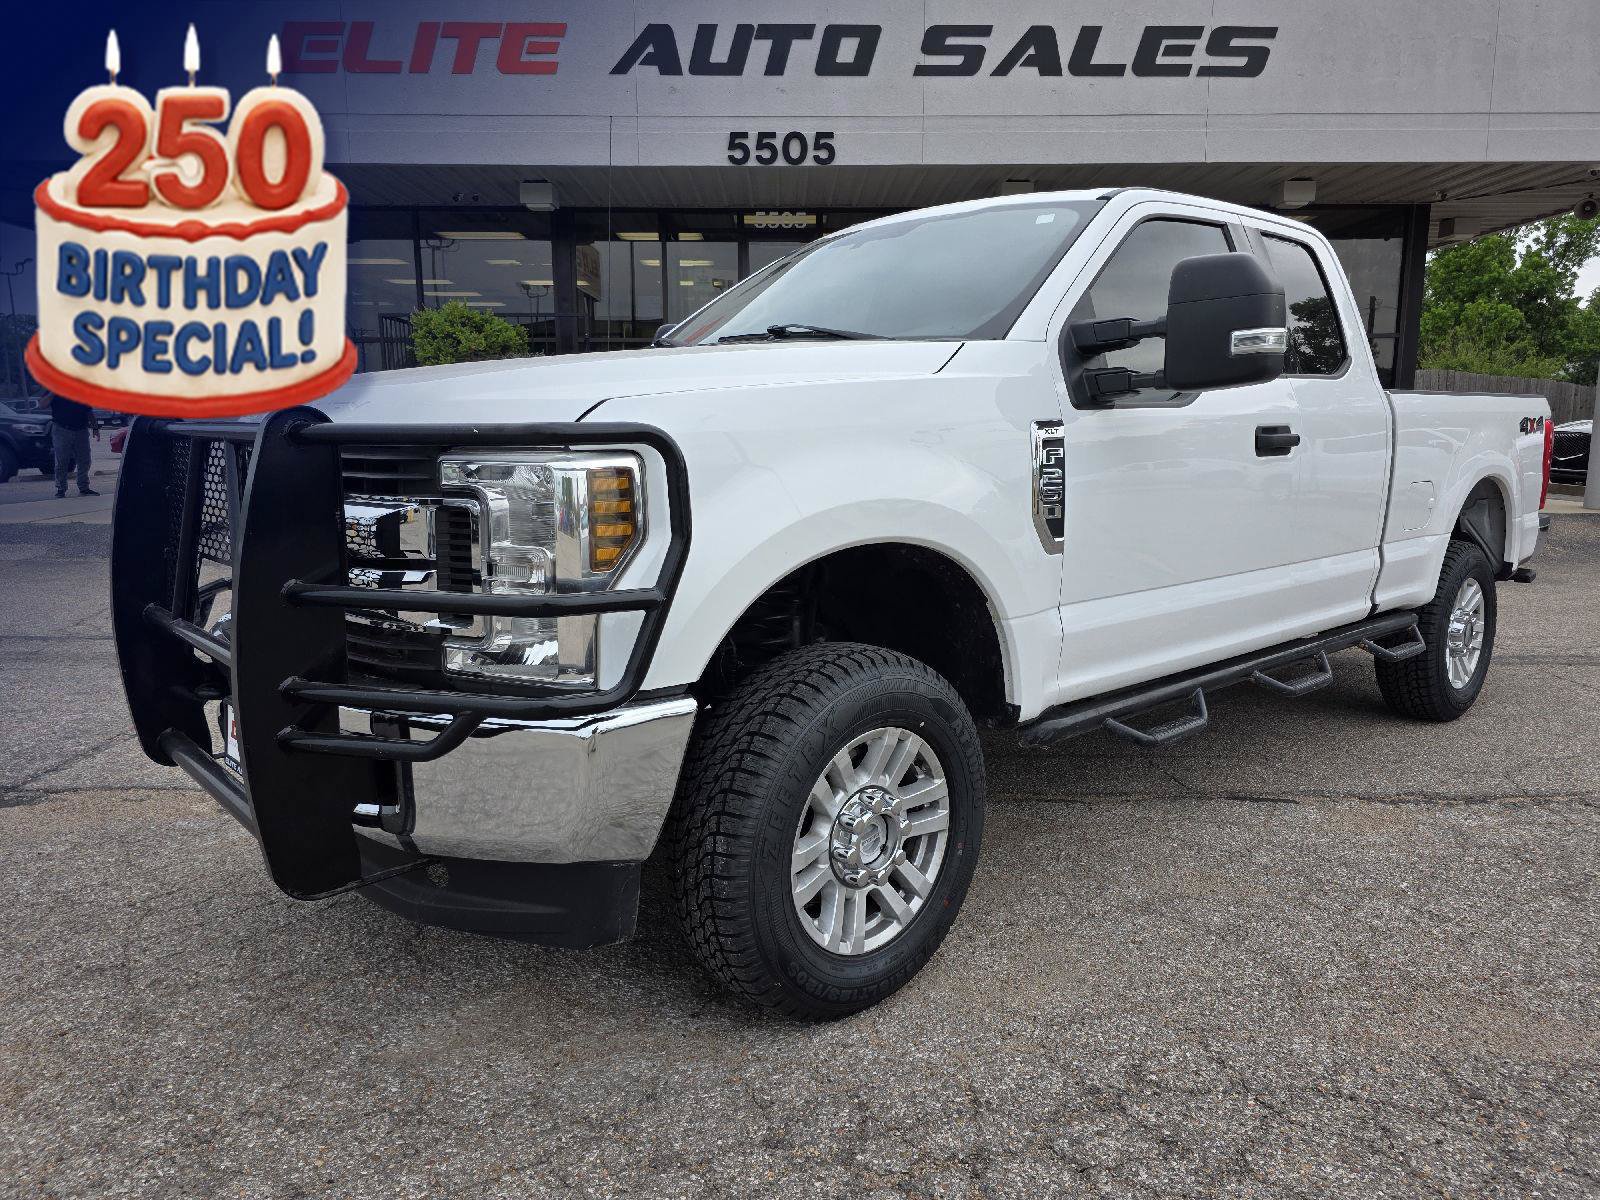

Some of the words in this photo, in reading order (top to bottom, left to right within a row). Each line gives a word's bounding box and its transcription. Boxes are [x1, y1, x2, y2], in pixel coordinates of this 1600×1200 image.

[281, 21, 567, 75] ELITE
[609, 23, 881, 76] AUTO
[913, 25, 1278, 78] SALES
[727, 131, 836, 166] 5505
[1044, 427, 1060, 436] XLT
